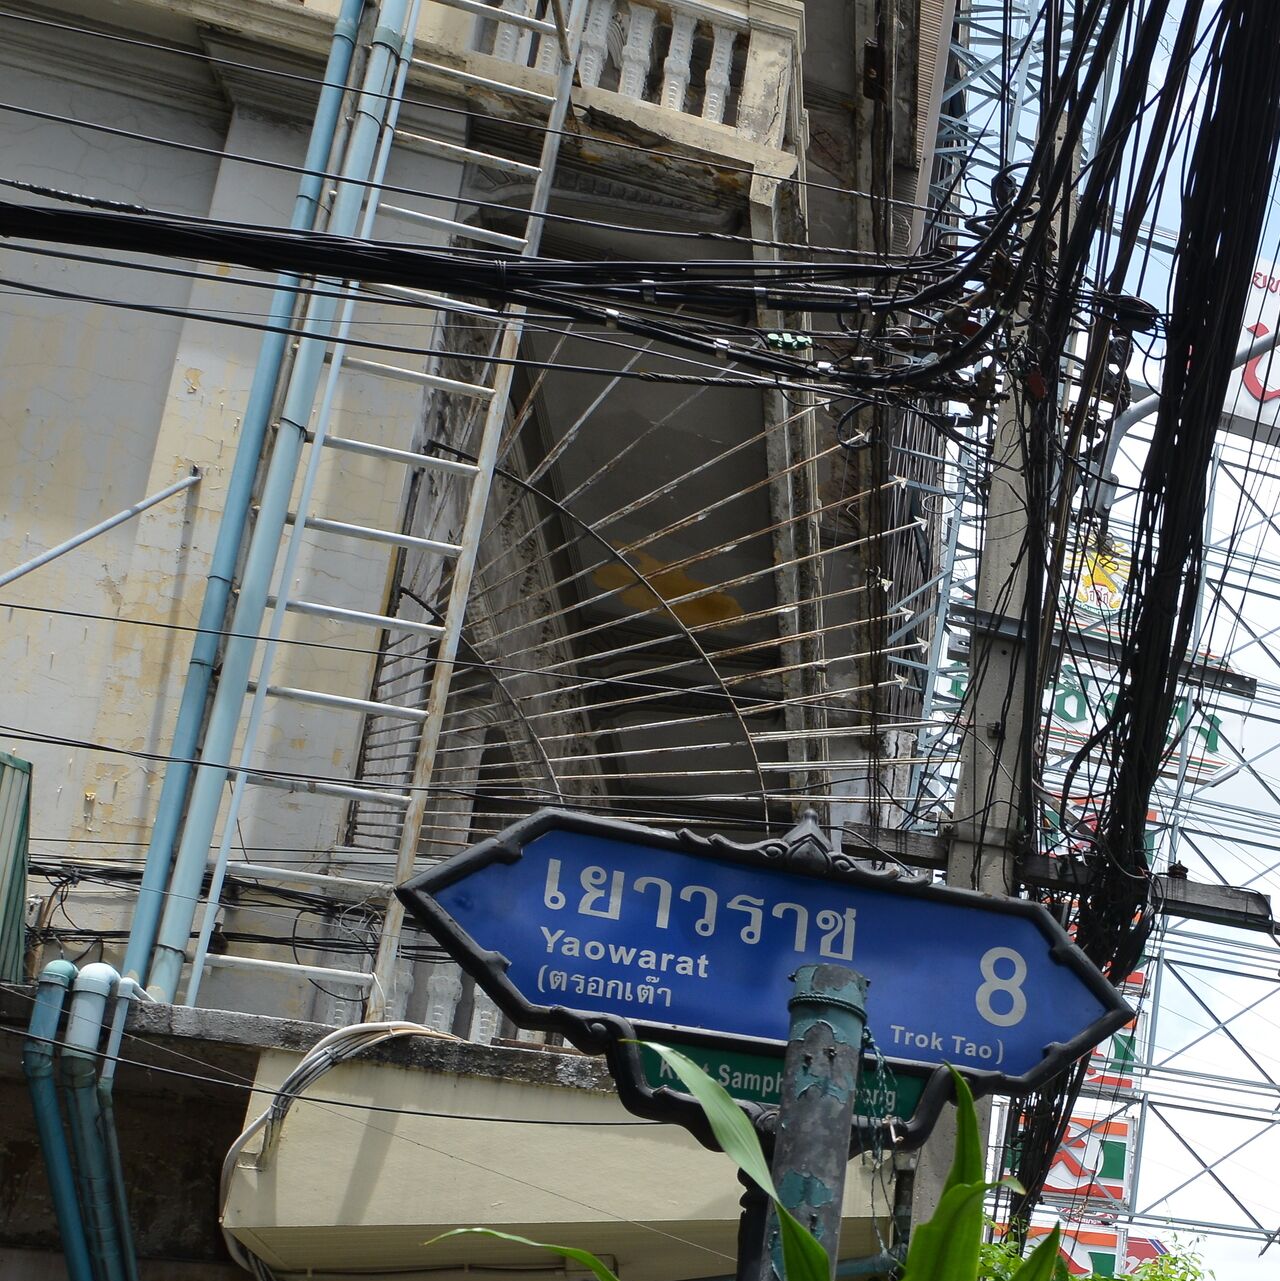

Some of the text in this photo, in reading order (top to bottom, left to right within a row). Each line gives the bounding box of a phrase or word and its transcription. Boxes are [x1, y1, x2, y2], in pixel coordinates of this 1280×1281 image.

[543, 858, 858, 961] เยาวราช
[540, 926, 710, 979] Yaowarat
[536, 966, 673, 1008] (ตรอกเต๊า
[975, 946, 1027, 1027] 8
[891, 1024, 1005, 1065] Trok Tao)
